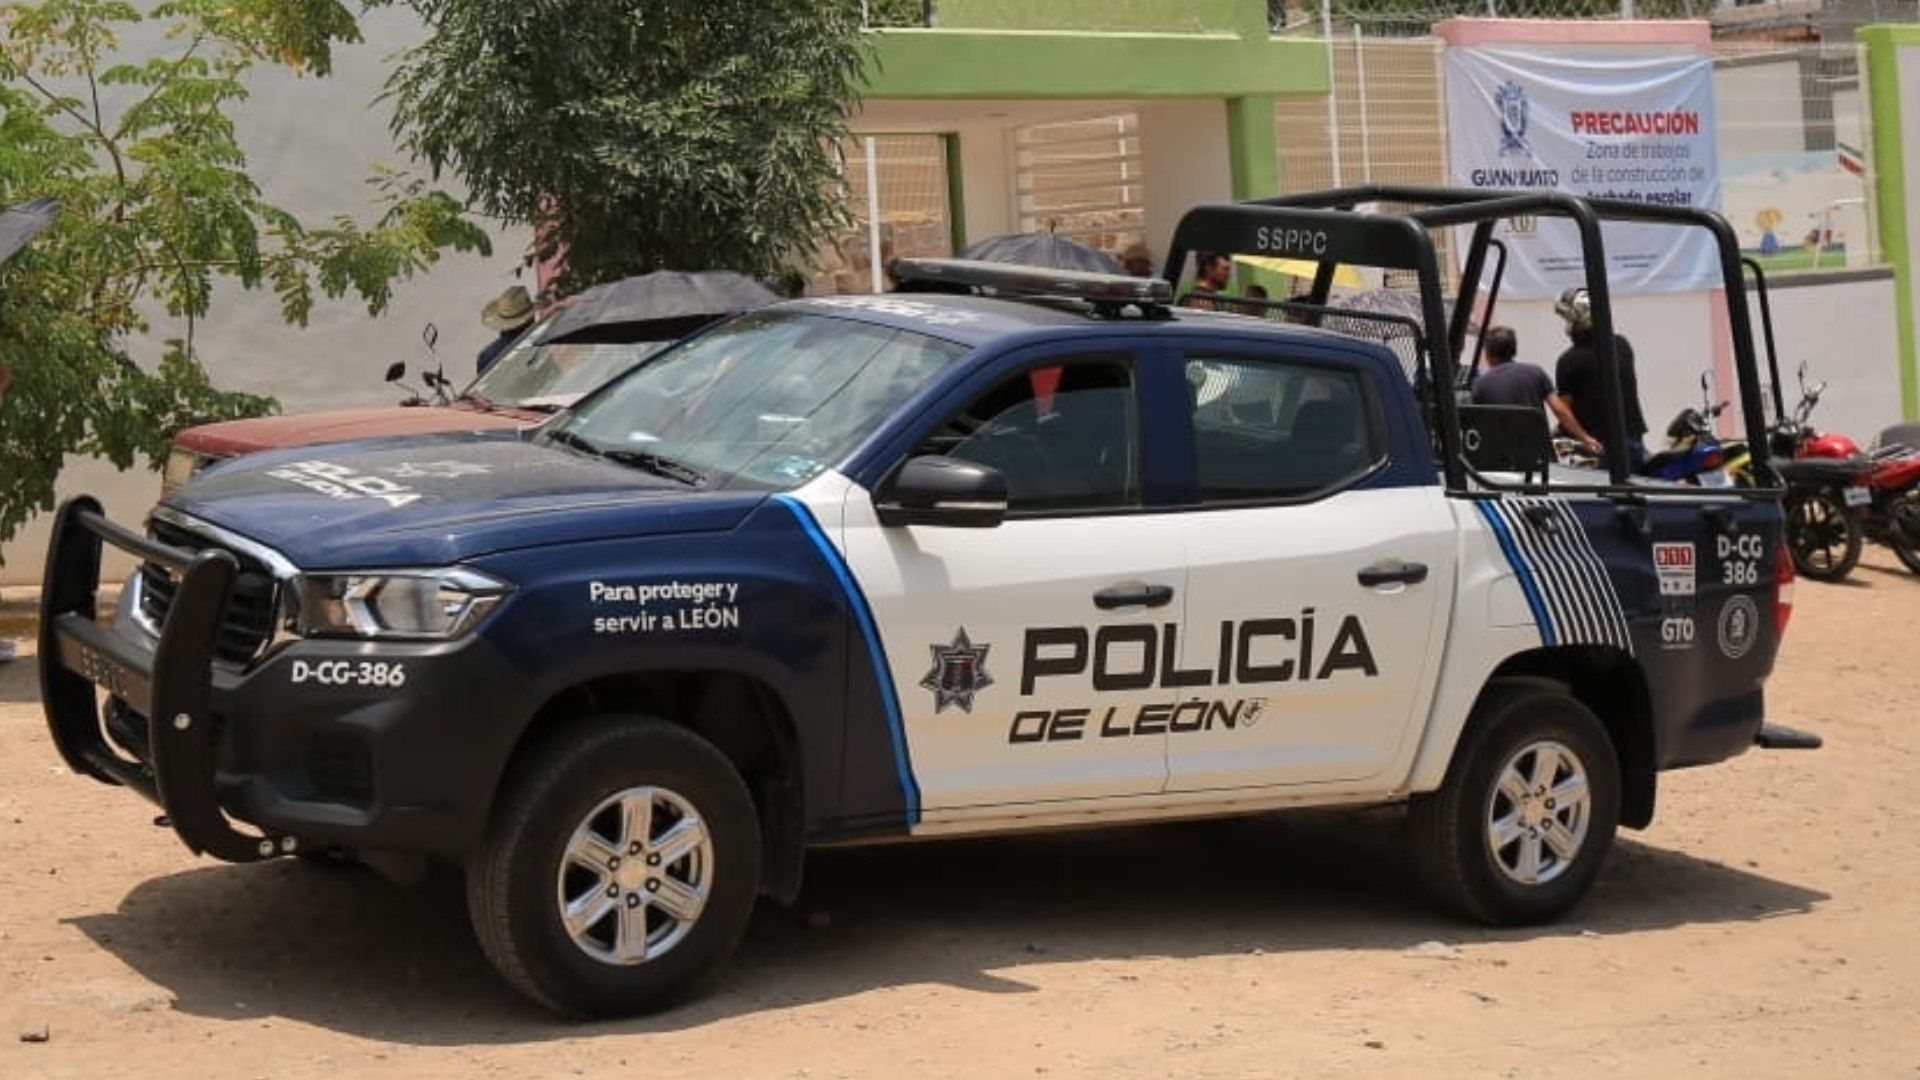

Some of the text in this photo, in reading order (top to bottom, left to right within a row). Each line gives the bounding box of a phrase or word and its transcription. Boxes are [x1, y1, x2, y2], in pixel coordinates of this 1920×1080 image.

[1570, 105, 1699, 135] PRECAUCIÓN
[1586, 141, 1620, 160] Zona
[1622, 142, 1638, 159] de
[1256, 225, 1327, 254] SSPPC
[1716, 534, 1764, 559] D-CG
[1722, 561, 1758, 584] 386
[589, 580, 739, 606] Para proteger y
[594, 601, 739, 633] servir a LEÓN
[1661, 617, 1695, 642] GTO
[1019, 606, 1379, 696] POLICÍA
[291, 660, 405, 687] D-CG-386
[1008, 696, 1245, 744] DE LEÓN
